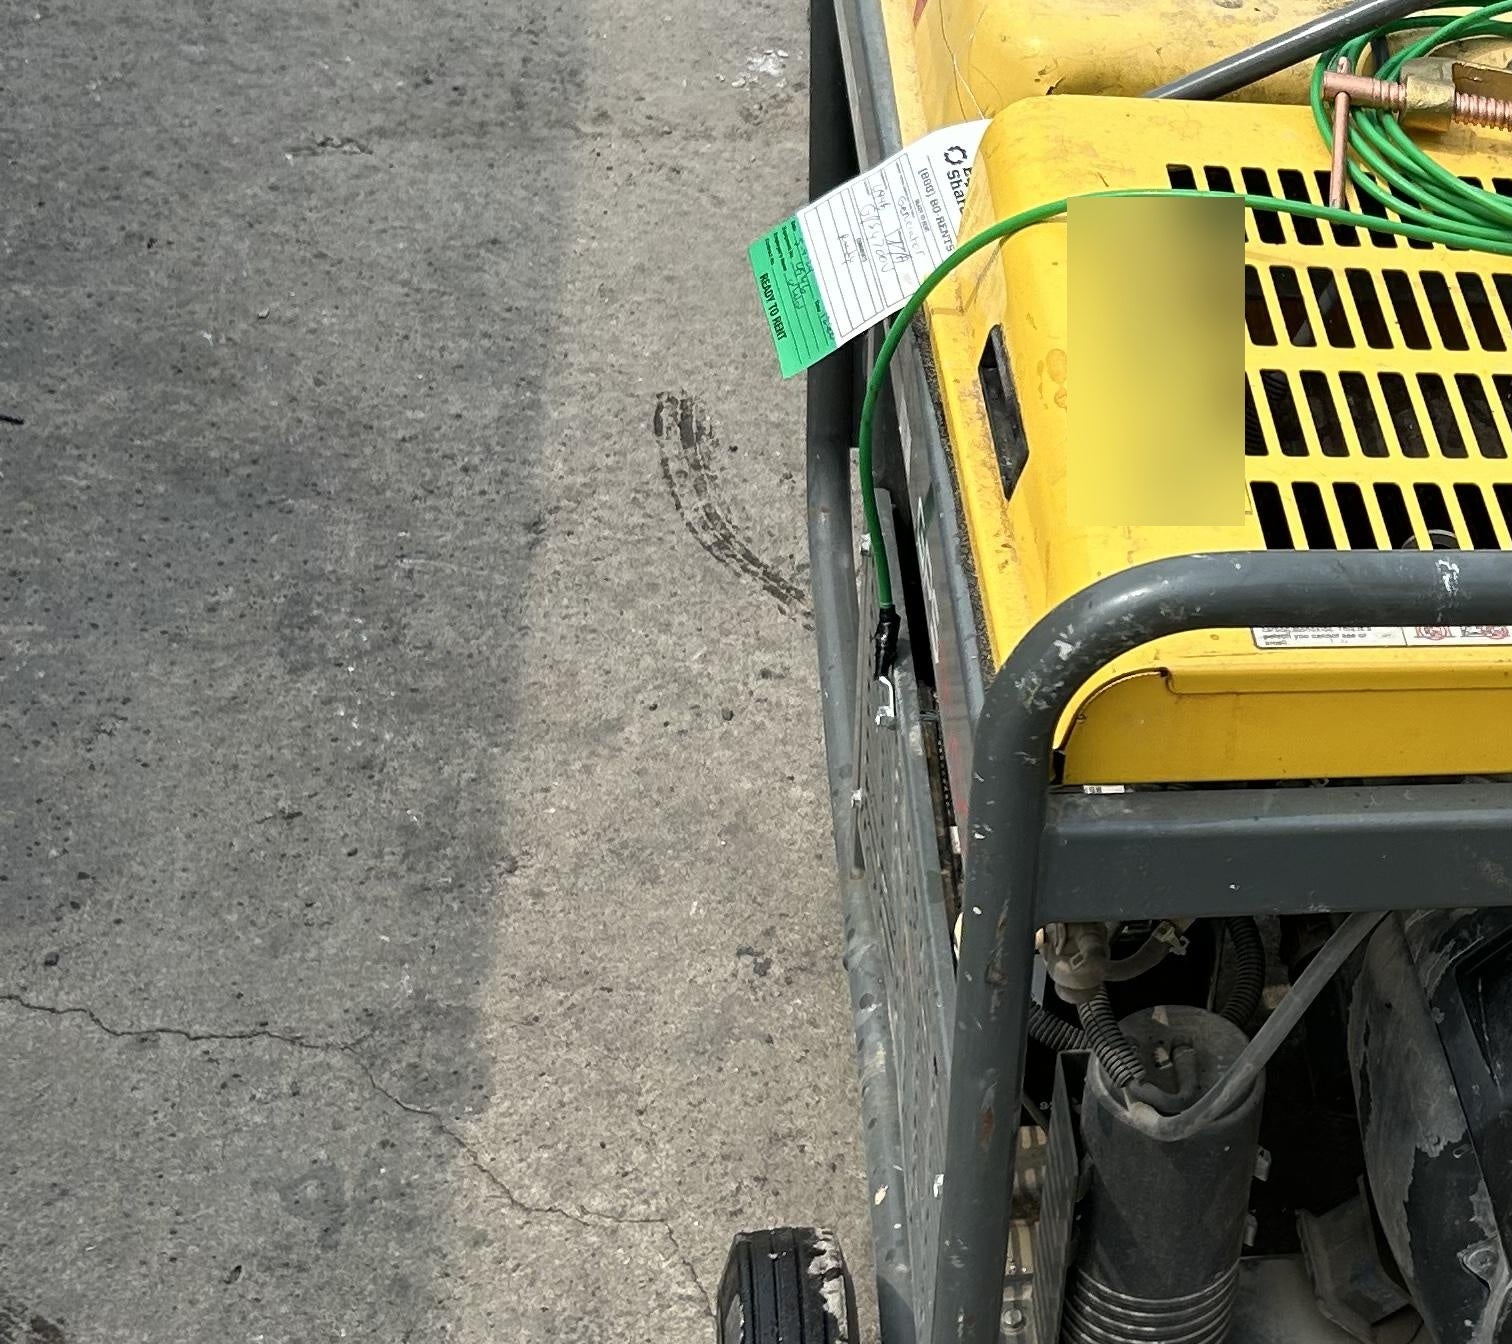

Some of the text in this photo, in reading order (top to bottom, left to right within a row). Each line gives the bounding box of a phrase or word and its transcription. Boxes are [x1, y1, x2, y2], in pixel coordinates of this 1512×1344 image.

[758, 271, 787, 341] READY TO RENT
